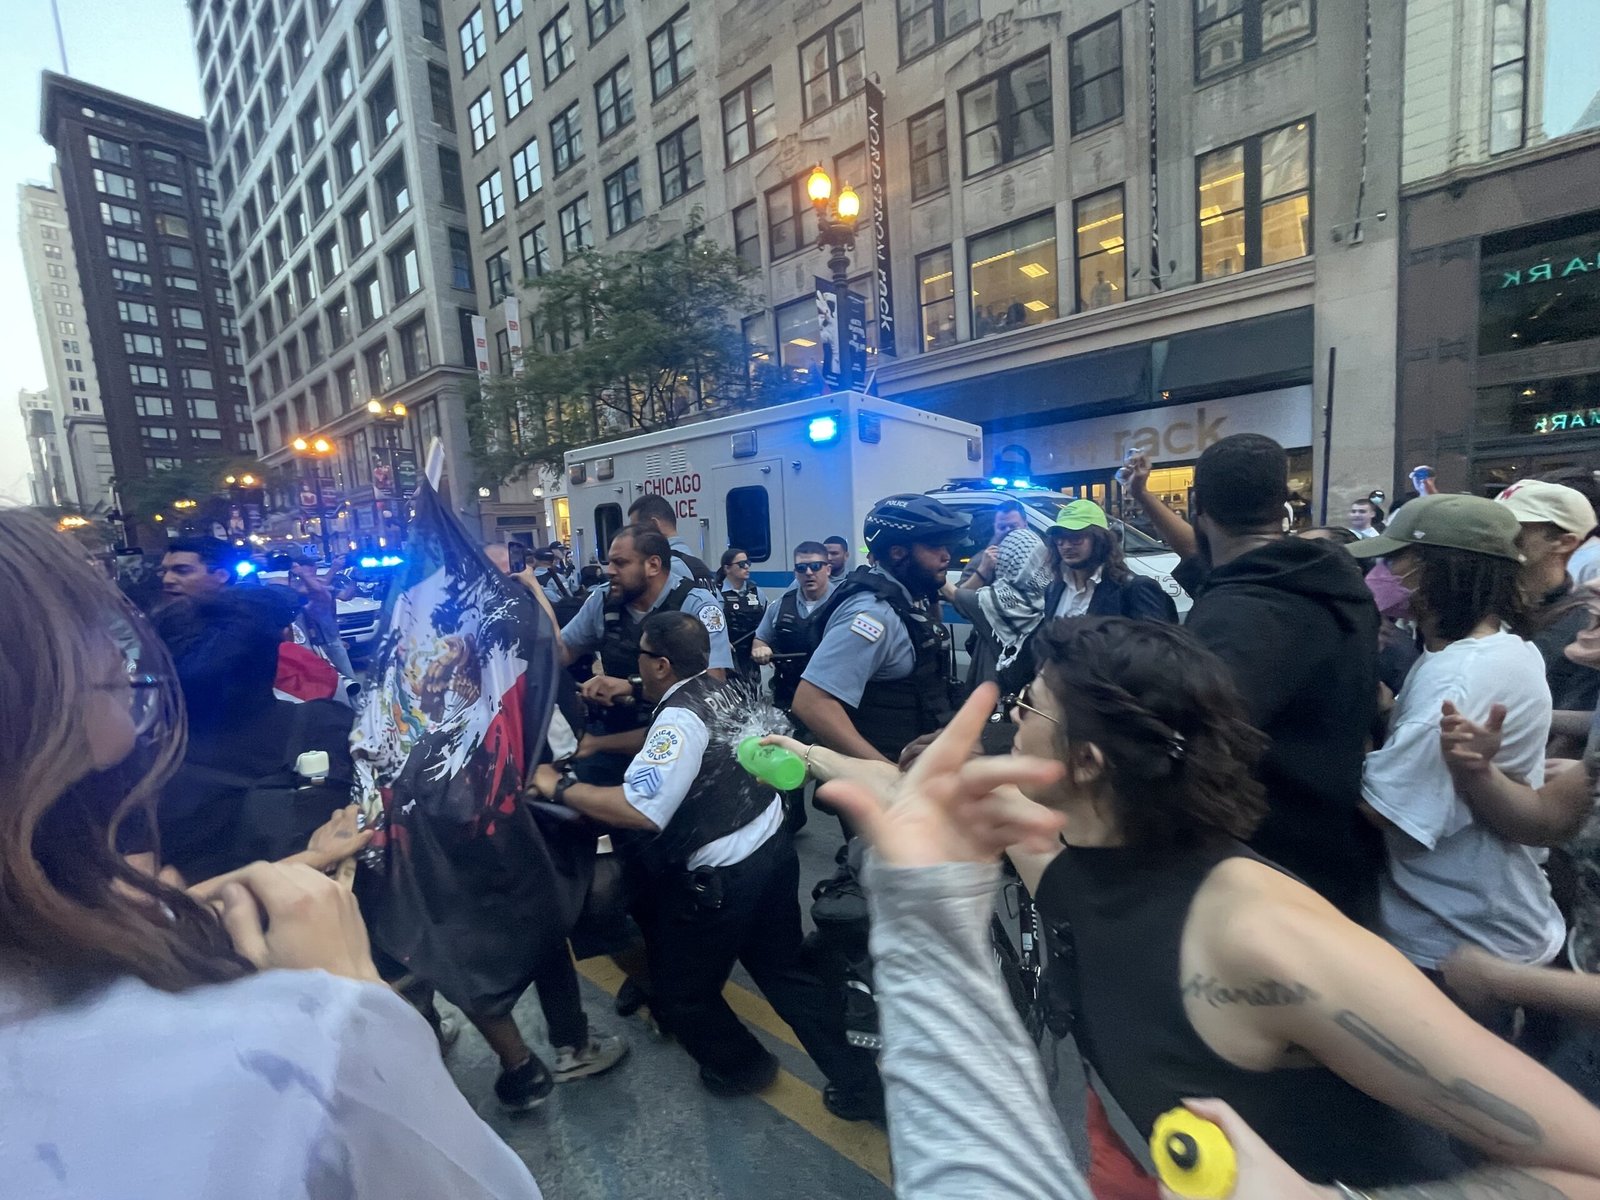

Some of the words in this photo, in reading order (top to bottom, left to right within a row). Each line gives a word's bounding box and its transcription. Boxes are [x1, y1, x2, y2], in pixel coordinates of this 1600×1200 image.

[867, 105, 885, 260] NORDSTROM
[878, 268, 893, 332] rack
[1112, 407, 1228, 462] rack
[644, 473, 701, 496] CHICAGO
[675, 499, 698, 518] ICE
[884, 500, 909, 508] POLICE
[649, 729, 678, 748] CHICAGO
[646, 748, 673, 761] POLICE
